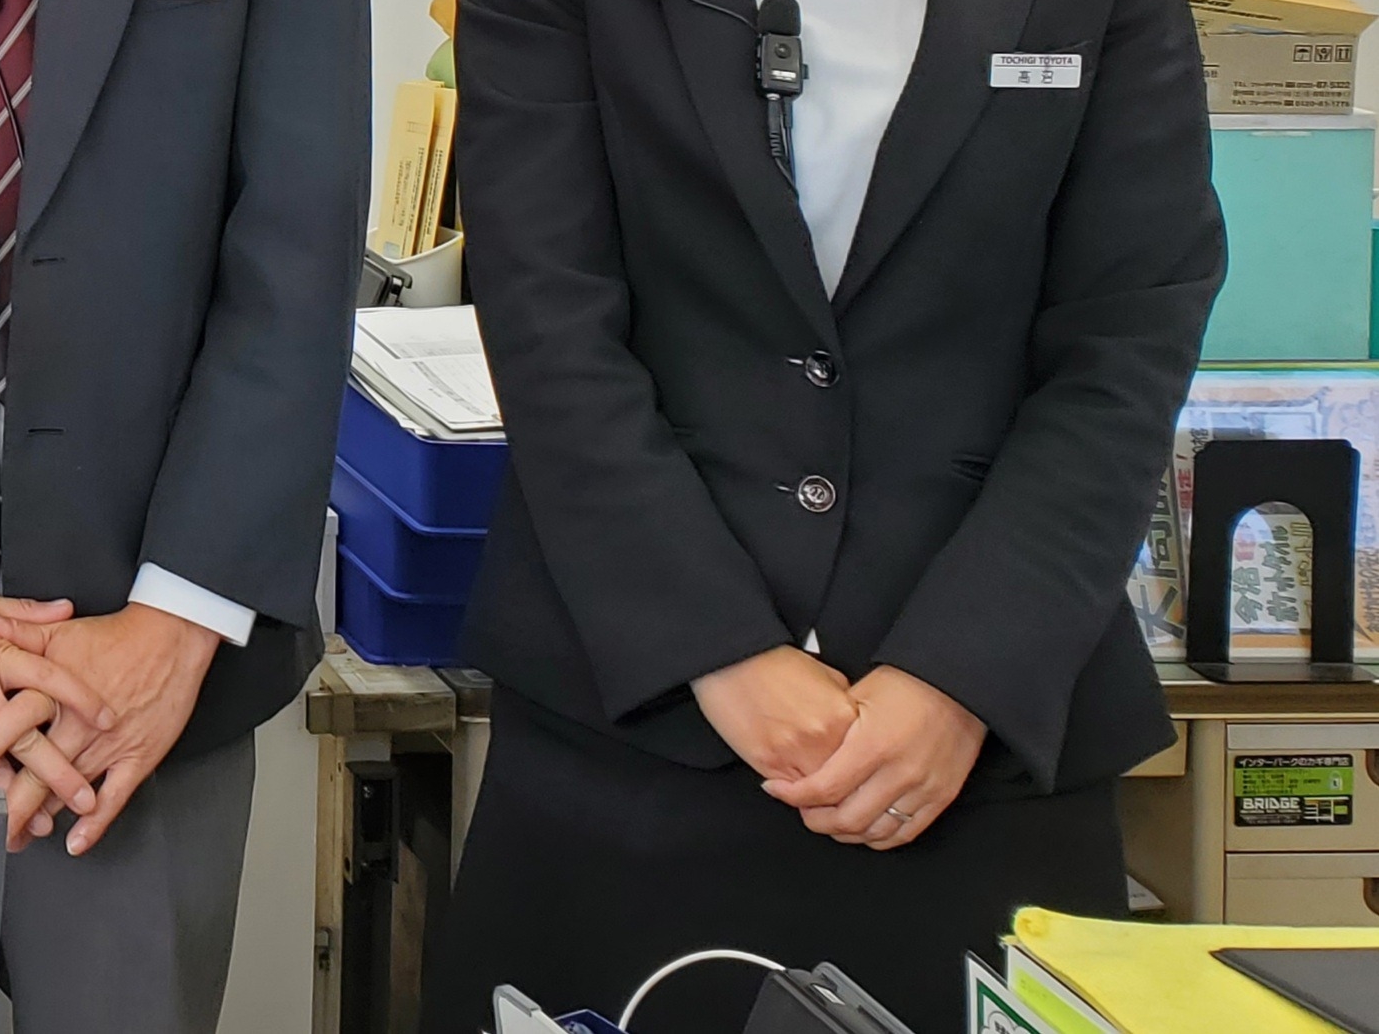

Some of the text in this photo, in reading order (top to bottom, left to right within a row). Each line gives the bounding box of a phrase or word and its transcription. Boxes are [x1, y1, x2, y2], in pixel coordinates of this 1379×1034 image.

[1001, 56, 1073, 65] TOCHIGI TOYOTA
[1242, 797, 1301, 810] BRIDGE
